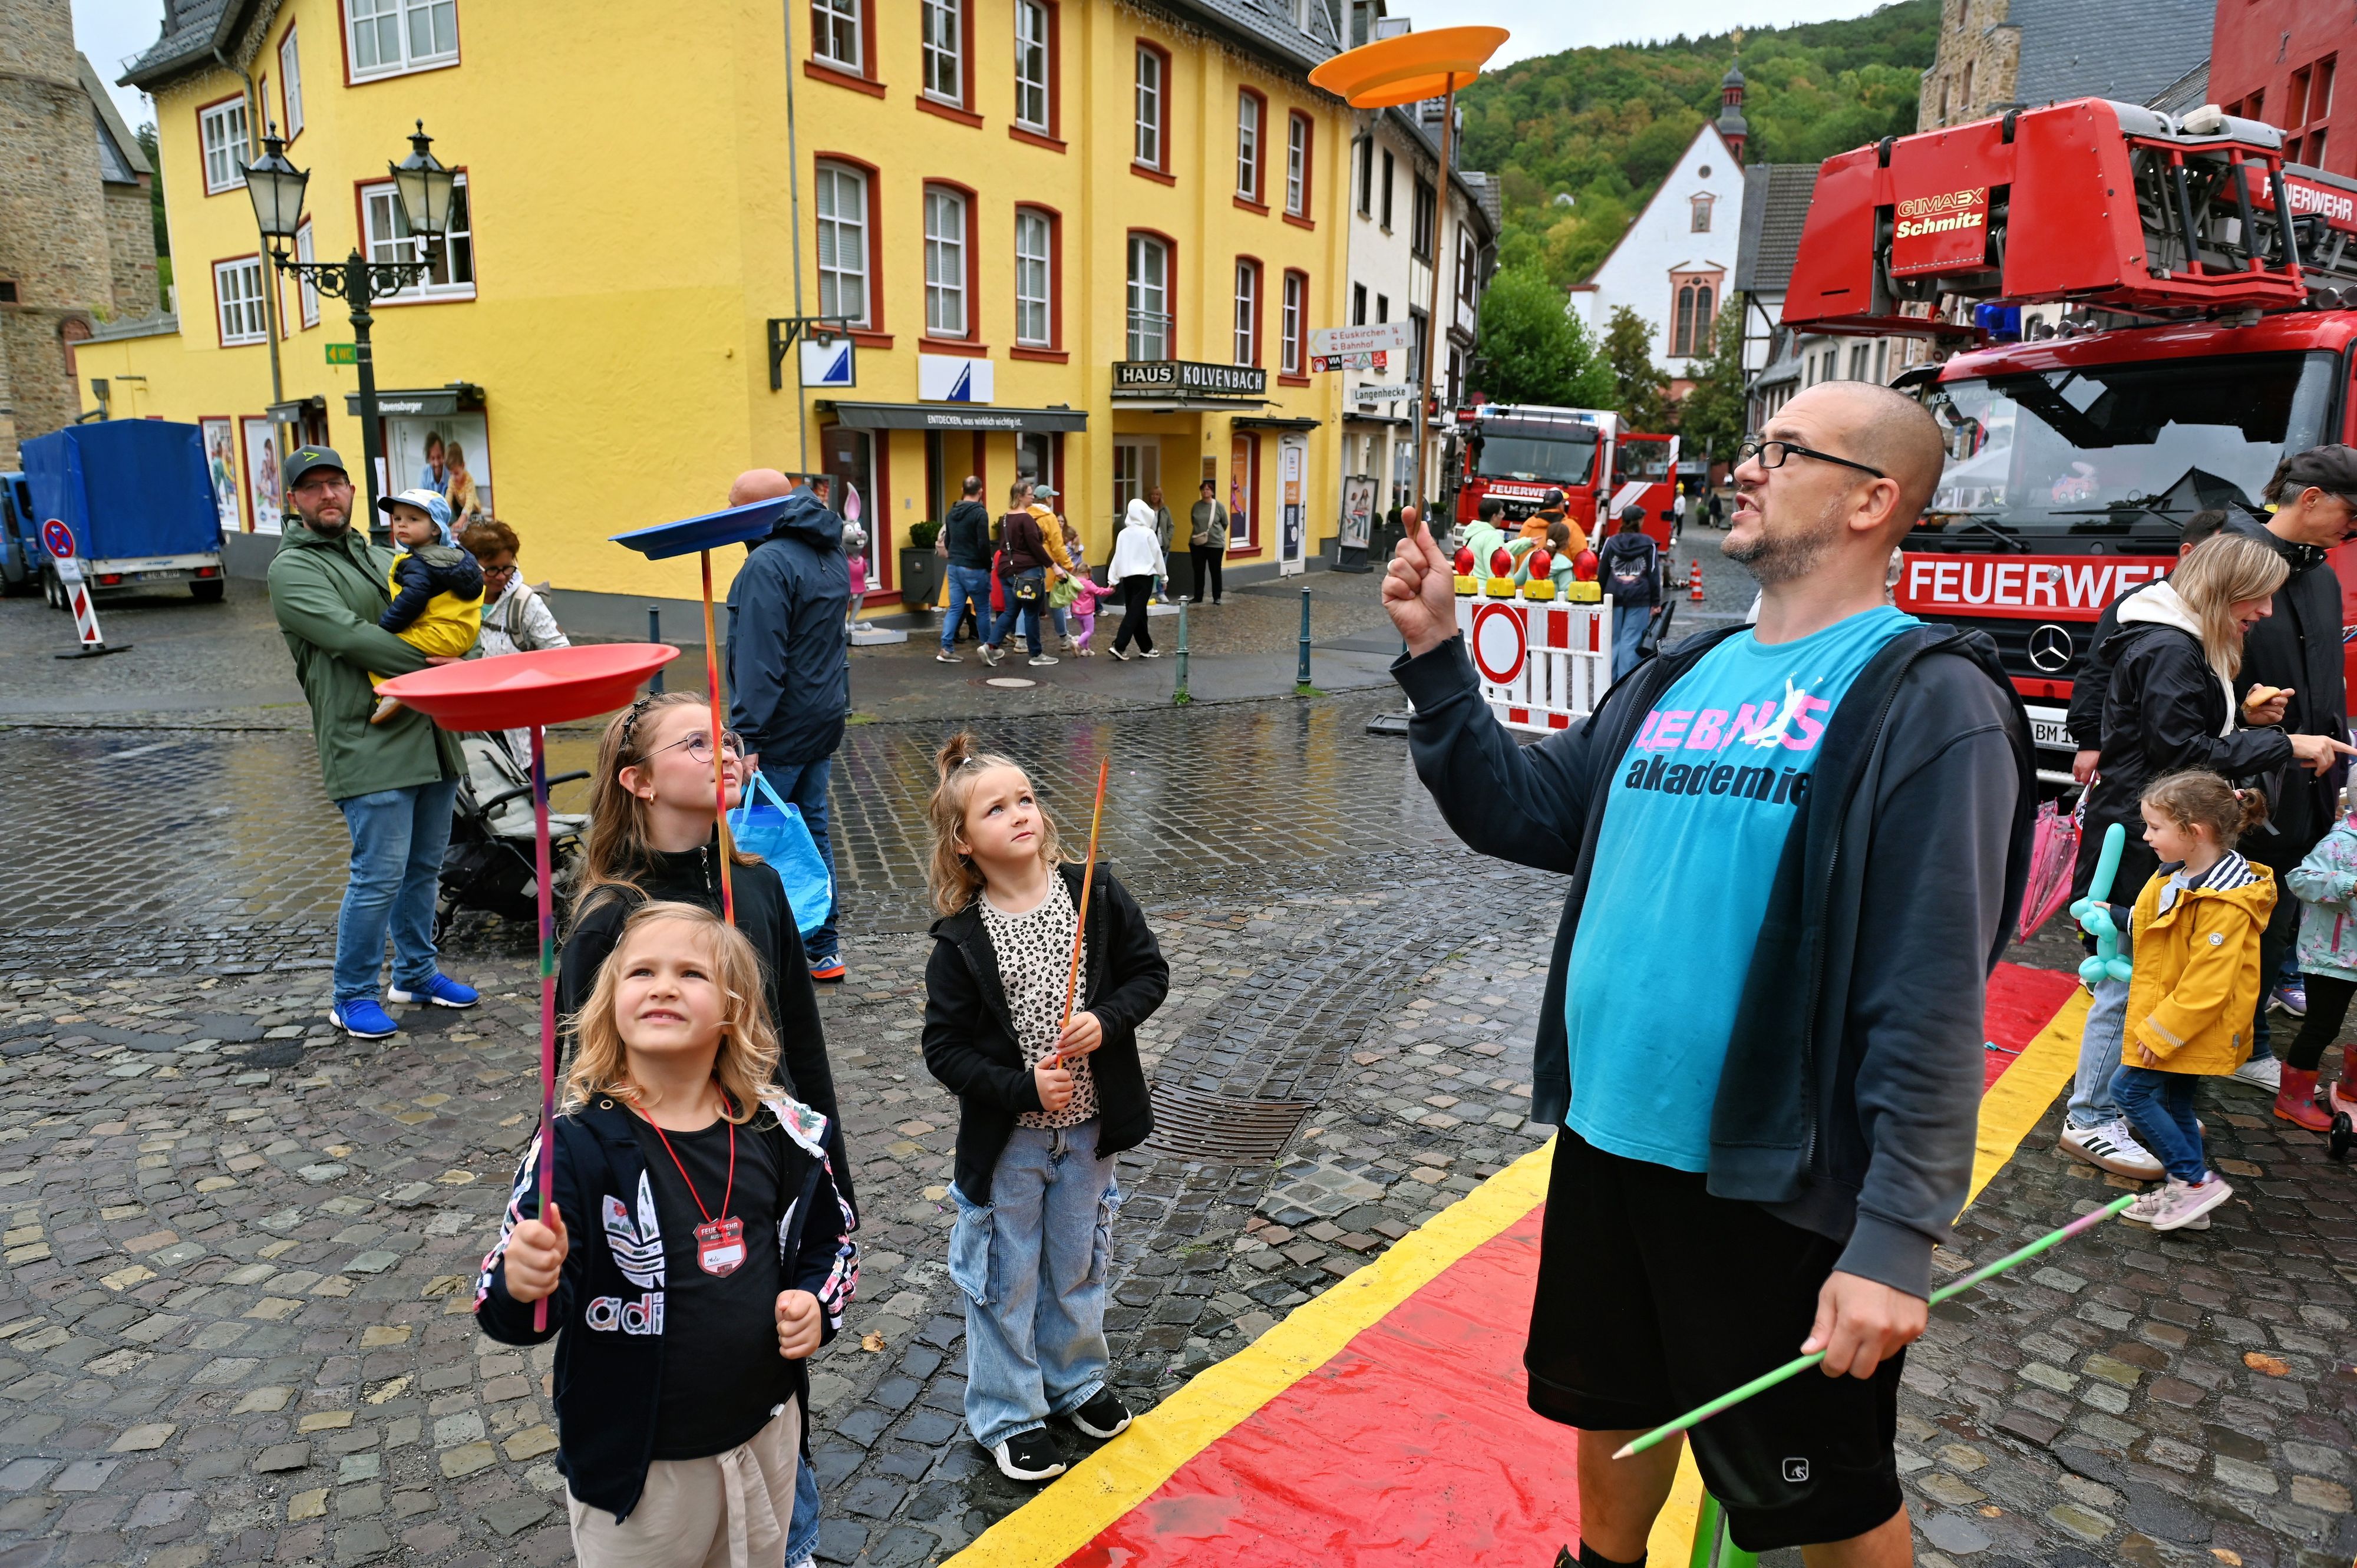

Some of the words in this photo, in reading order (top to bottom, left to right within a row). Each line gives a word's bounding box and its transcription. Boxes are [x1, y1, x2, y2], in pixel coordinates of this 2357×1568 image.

[1897, 187, 1985, 217] GIMAEX
[2262, 177, 2352, 221] FUERWEHR
[1896, 212, 1983, 238] Schmitz
[1339, 329, 1385, 339] Euskirchen
[1341, 341, 1374, 350] Bahnhof
[338, 348, 352, 361] WC
[1123, 368, 1171, 382] HAUS
[1183, 365, 1262, 390] KOLVENBACH
[1355, 387, 1405, 401] Langenhecke
[378, 401, 422, 413] Ravensburger
[927, 415, 963, 427] ENTDECKEN,
[974, 417, 995, 425] wirklich
[995, 417, 1014, 428] wichtig
[1508, 504, 1540, 513] MAN
[1909, 561, 2164, 608] FEUERWE
[2036, 724, 2058, 742] BM
[1625, 754, 1813, 807] akademie
[585, 1292, 664, 1335] adi
